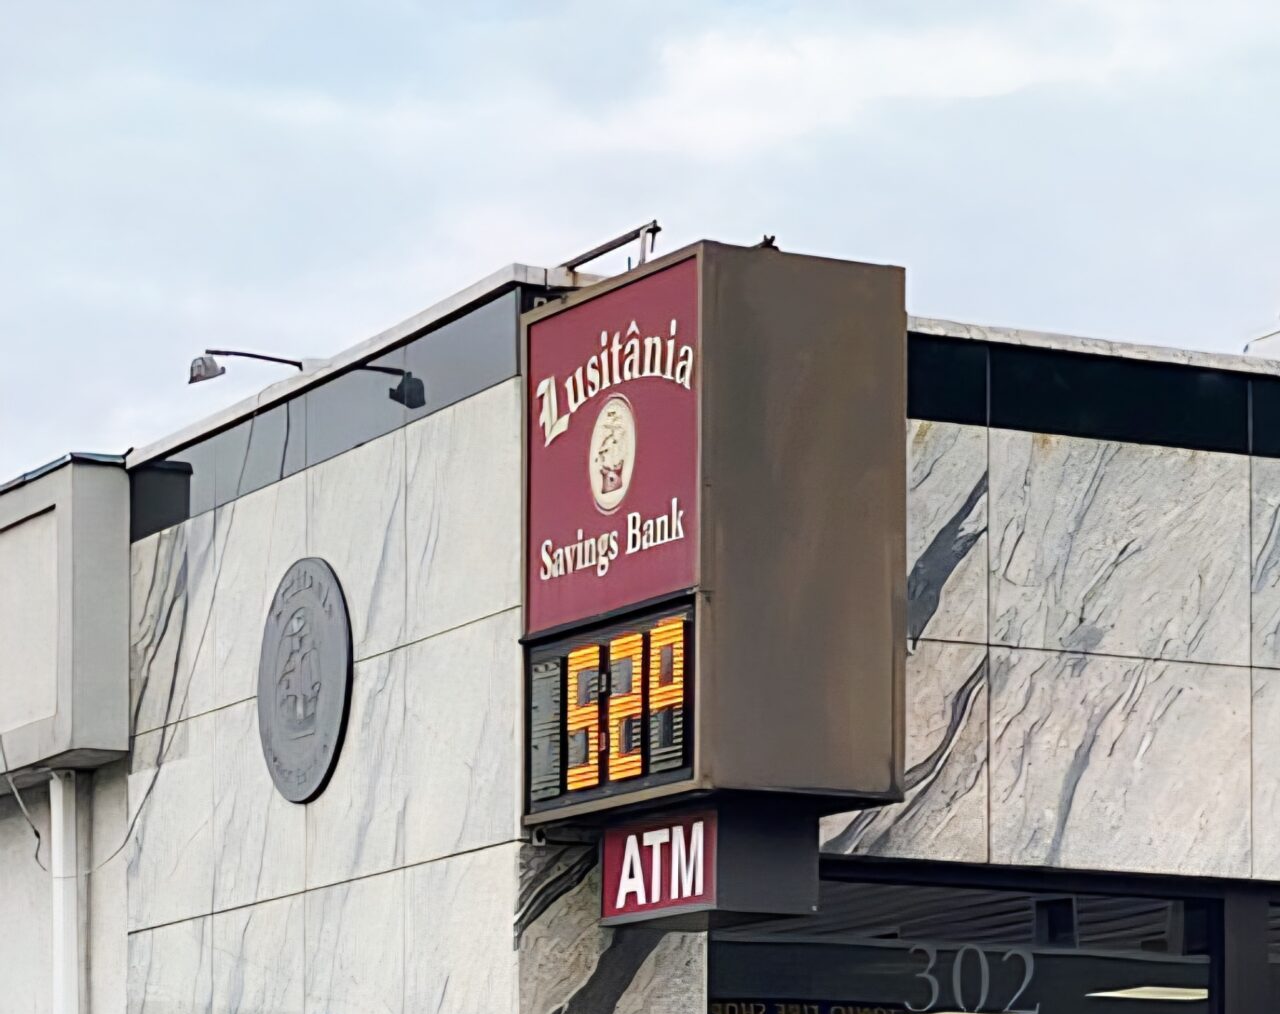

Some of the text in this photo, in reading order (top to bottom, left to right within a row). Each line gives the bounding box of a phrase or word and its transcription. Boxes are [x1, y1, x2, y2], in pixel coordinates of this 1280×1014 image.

[536, 318, 694, 448] Lusitânia
[540, 497, 685, 581] Savings Bank
[615, 820, 704, 910] ATM
